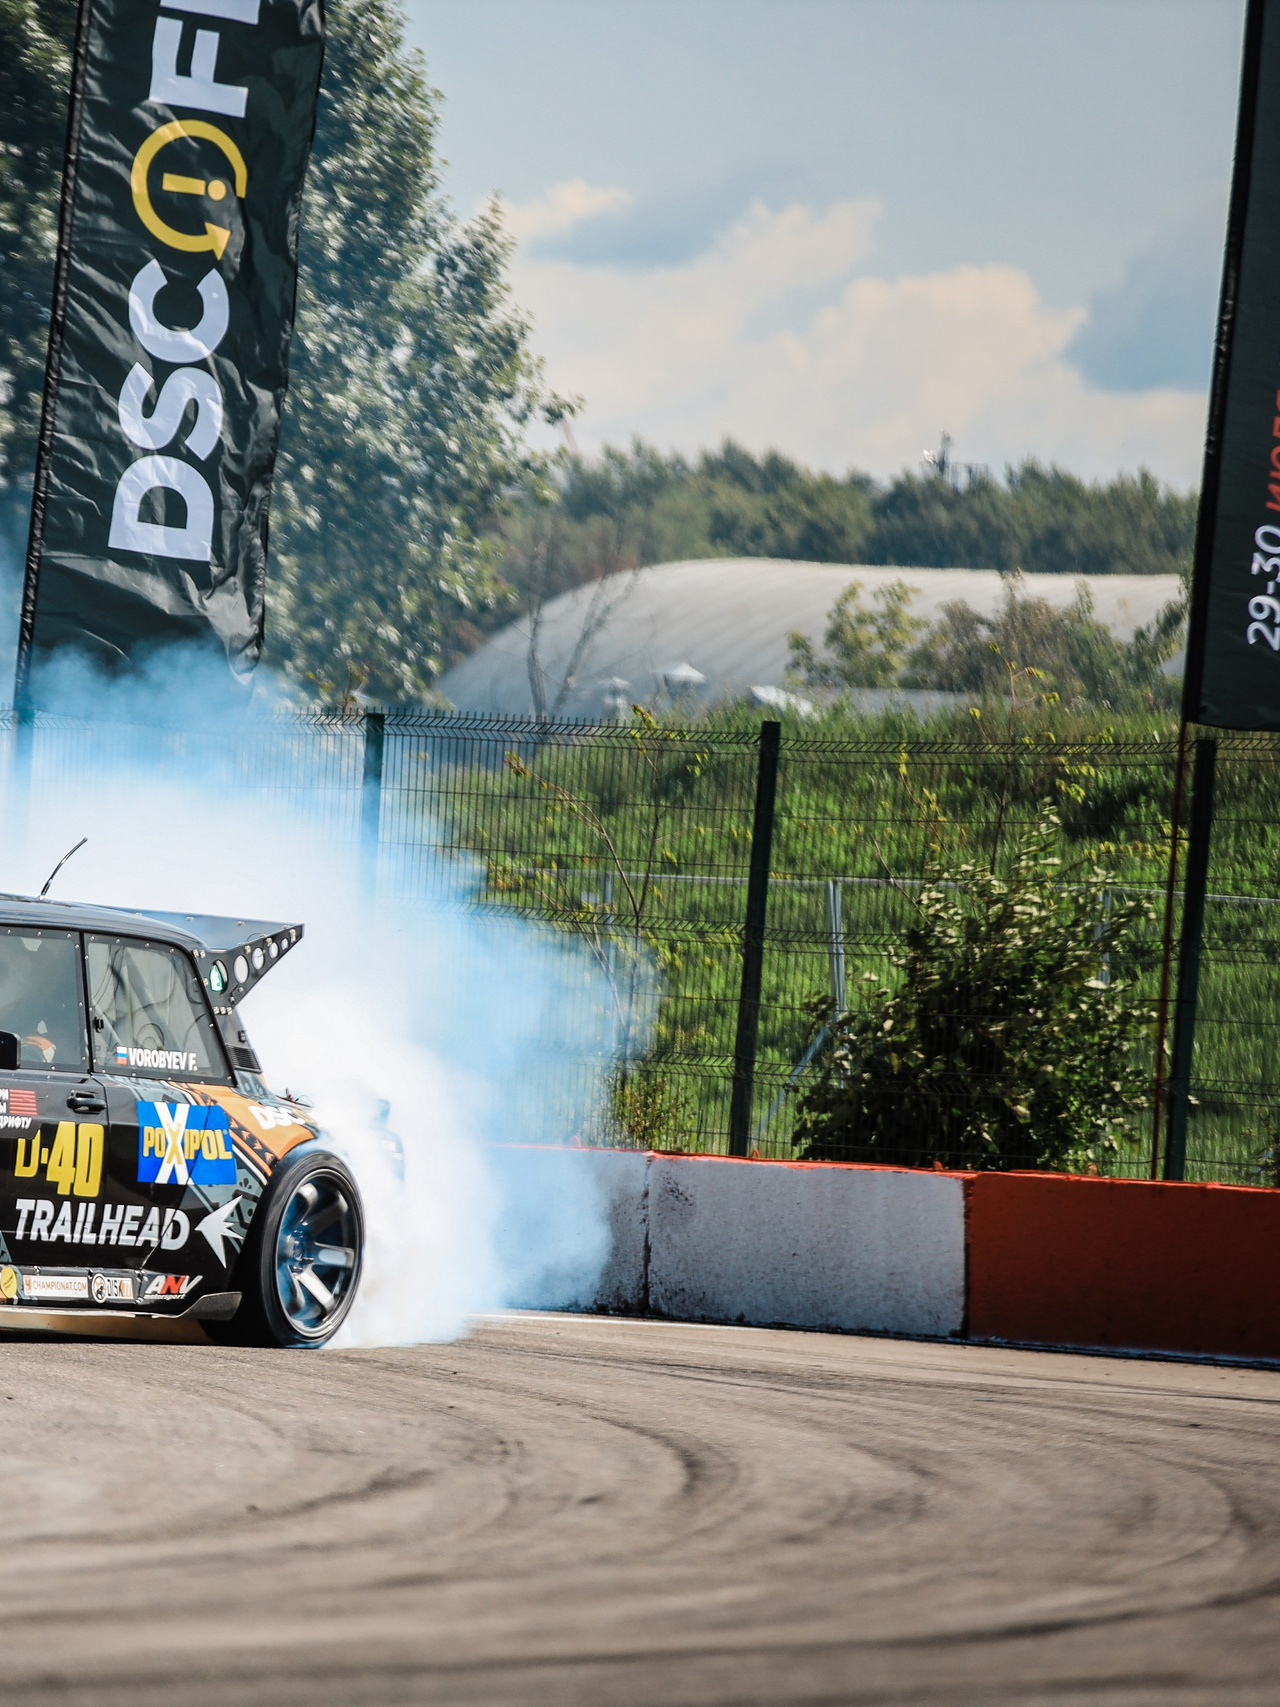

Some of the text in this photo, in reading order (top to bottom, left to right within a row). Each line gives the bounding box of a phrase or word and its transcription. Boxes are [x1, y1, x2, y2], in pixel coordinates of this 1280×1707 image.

[128, 1047, 198, 1071] VOROBYEV F.
[142, 1121, 233, 1165] POXIPOL
[15, 1198, 190, 1252] TRAILHEAD
[33, 1279, 87, 1292] CHAMPIONAT.COM
